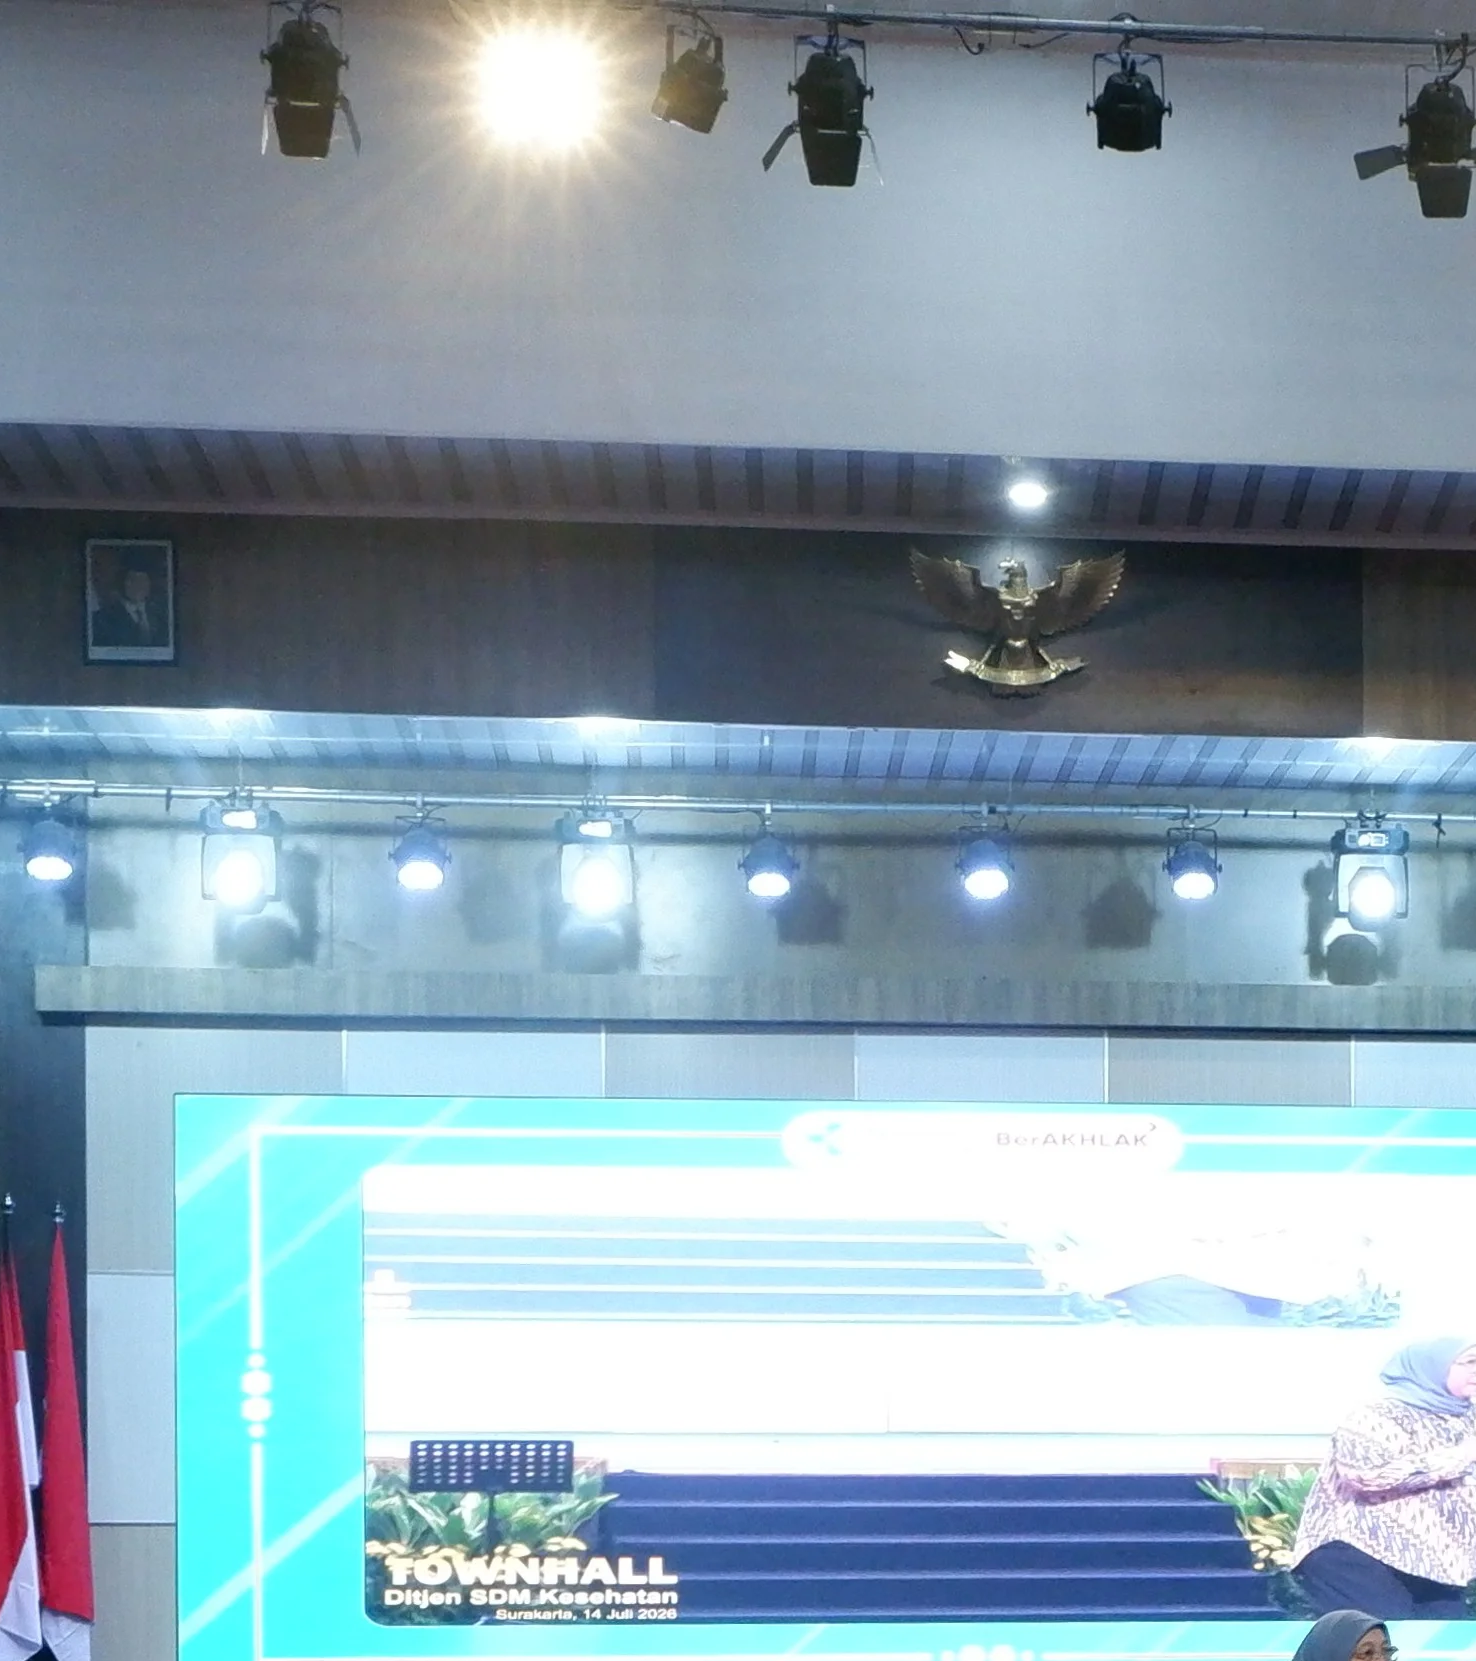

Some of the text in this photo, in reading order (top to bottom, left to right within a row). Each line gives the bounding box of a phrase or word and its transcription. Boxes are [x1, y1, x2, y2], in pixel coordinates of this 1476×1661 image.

[997, 1132, 1147, 1146] BerAKHLAK
[384, 1556, 678, 1586] TOWNHALL
[384, 1588, 678, 1609] Ditjen SDM Kesehatan
[583, 1608, 602, 1620] 14
[606, 1608, 634, 1621] Juli
